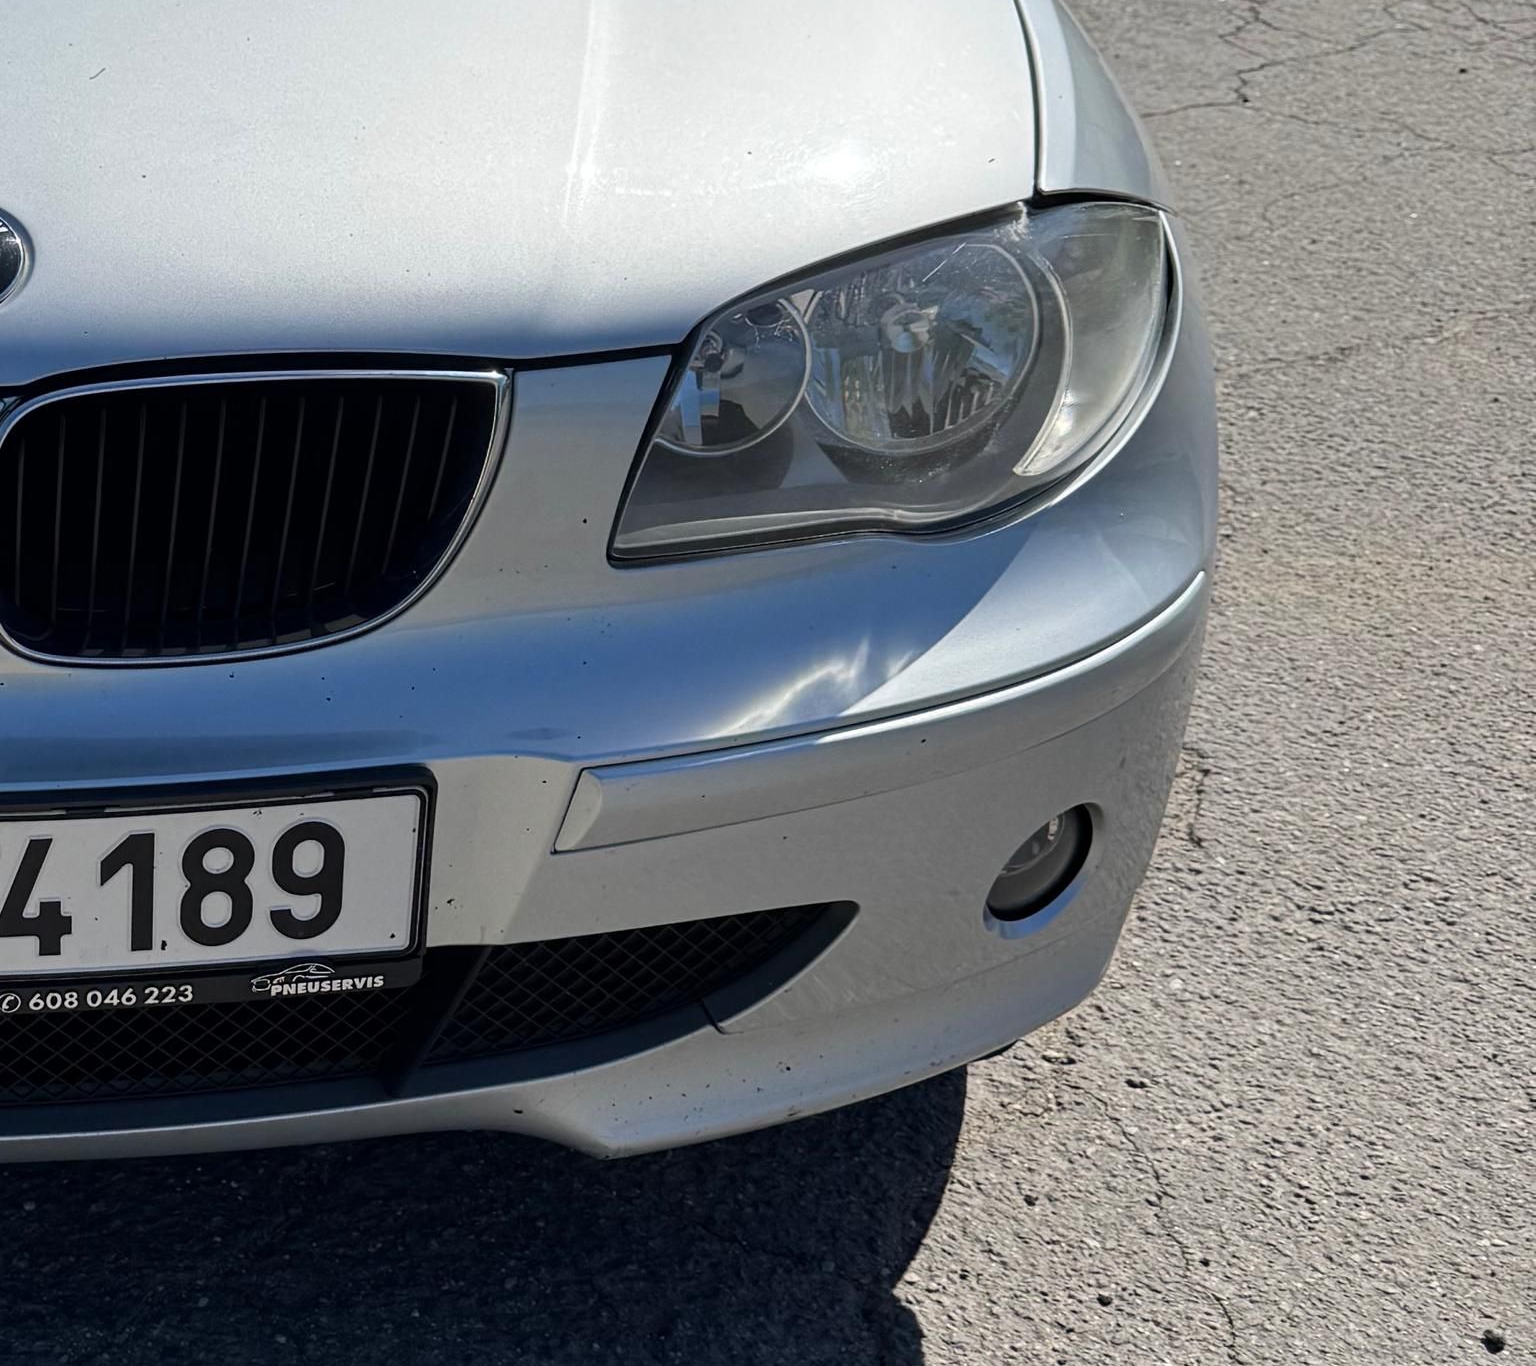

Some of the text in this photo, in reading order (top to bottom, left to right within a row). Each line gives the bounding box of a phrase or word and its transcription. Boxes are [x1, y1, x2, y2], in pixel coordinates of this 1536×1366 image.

[28, 984, 193, 1011] 608 046 223
[270, 975, 384, 996] PNEUSERVIS
